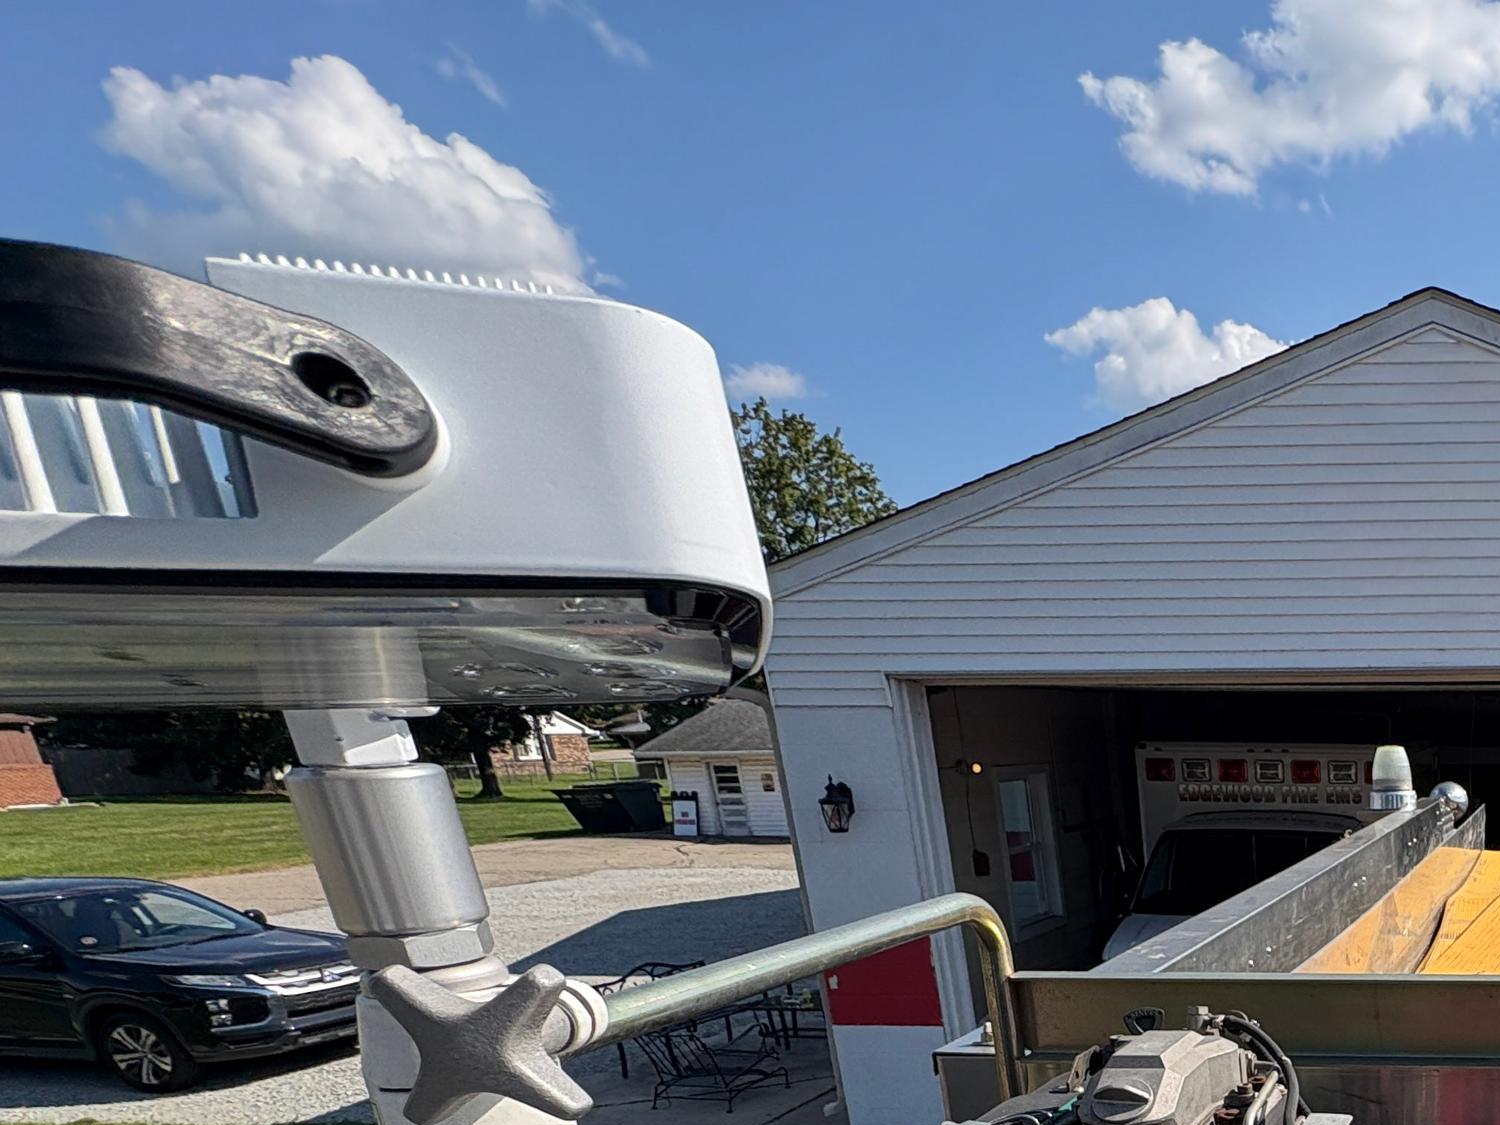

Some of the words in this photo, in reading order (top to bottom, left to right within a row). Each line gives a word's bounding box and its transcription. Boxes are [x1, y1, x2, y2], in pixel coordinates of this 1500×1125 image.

[1178, 784, 1275, 803] EDGEWOOD
[1281, 785, 1319, 804] FIRE
[1325, 786, 1362, 805] EMS
